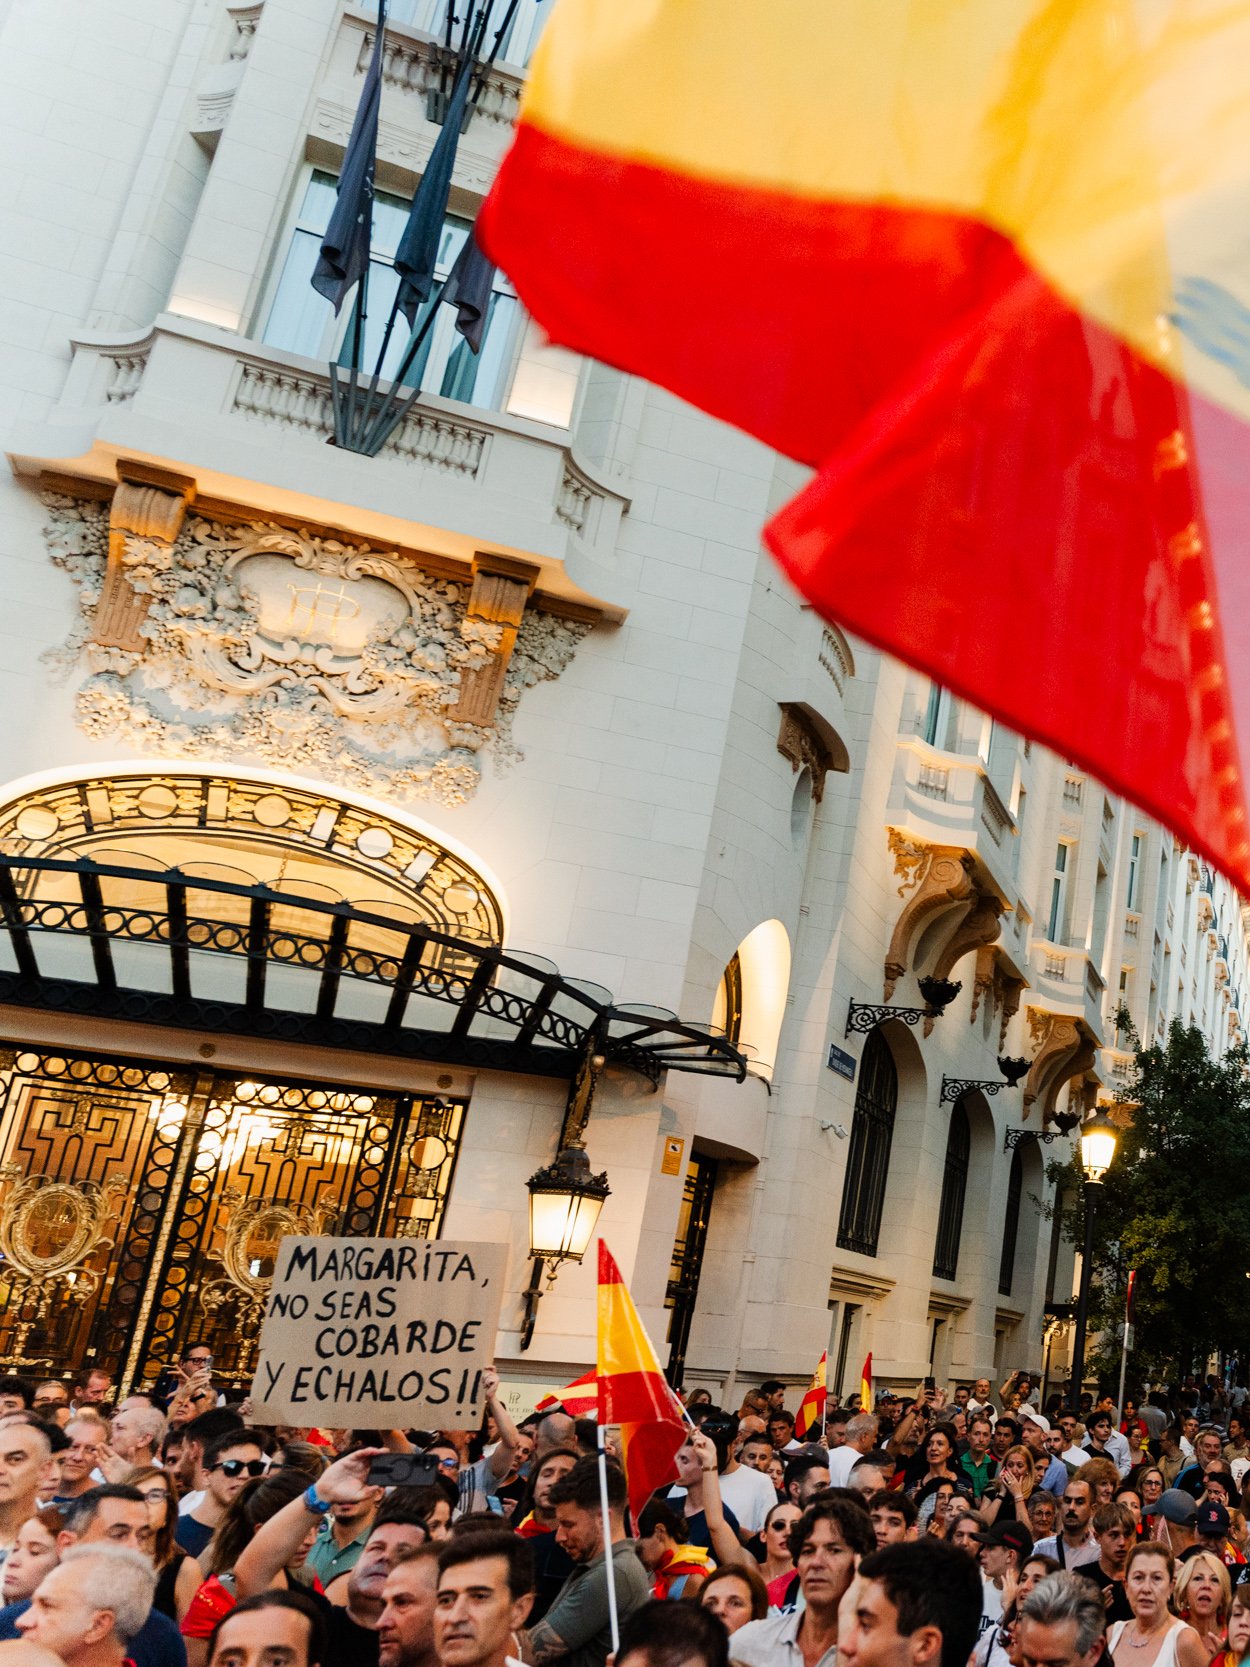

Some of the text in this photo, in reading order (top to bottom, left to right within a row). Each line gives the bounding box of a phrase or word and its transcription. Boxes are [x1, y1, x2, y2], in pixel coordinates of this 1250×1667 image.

[269, 1287, 397, 1321] NO SEAS
[315, 1320, 482, 1359] COBARDE
[263, 1361, 483, 1417] Y ECHALOS!!
